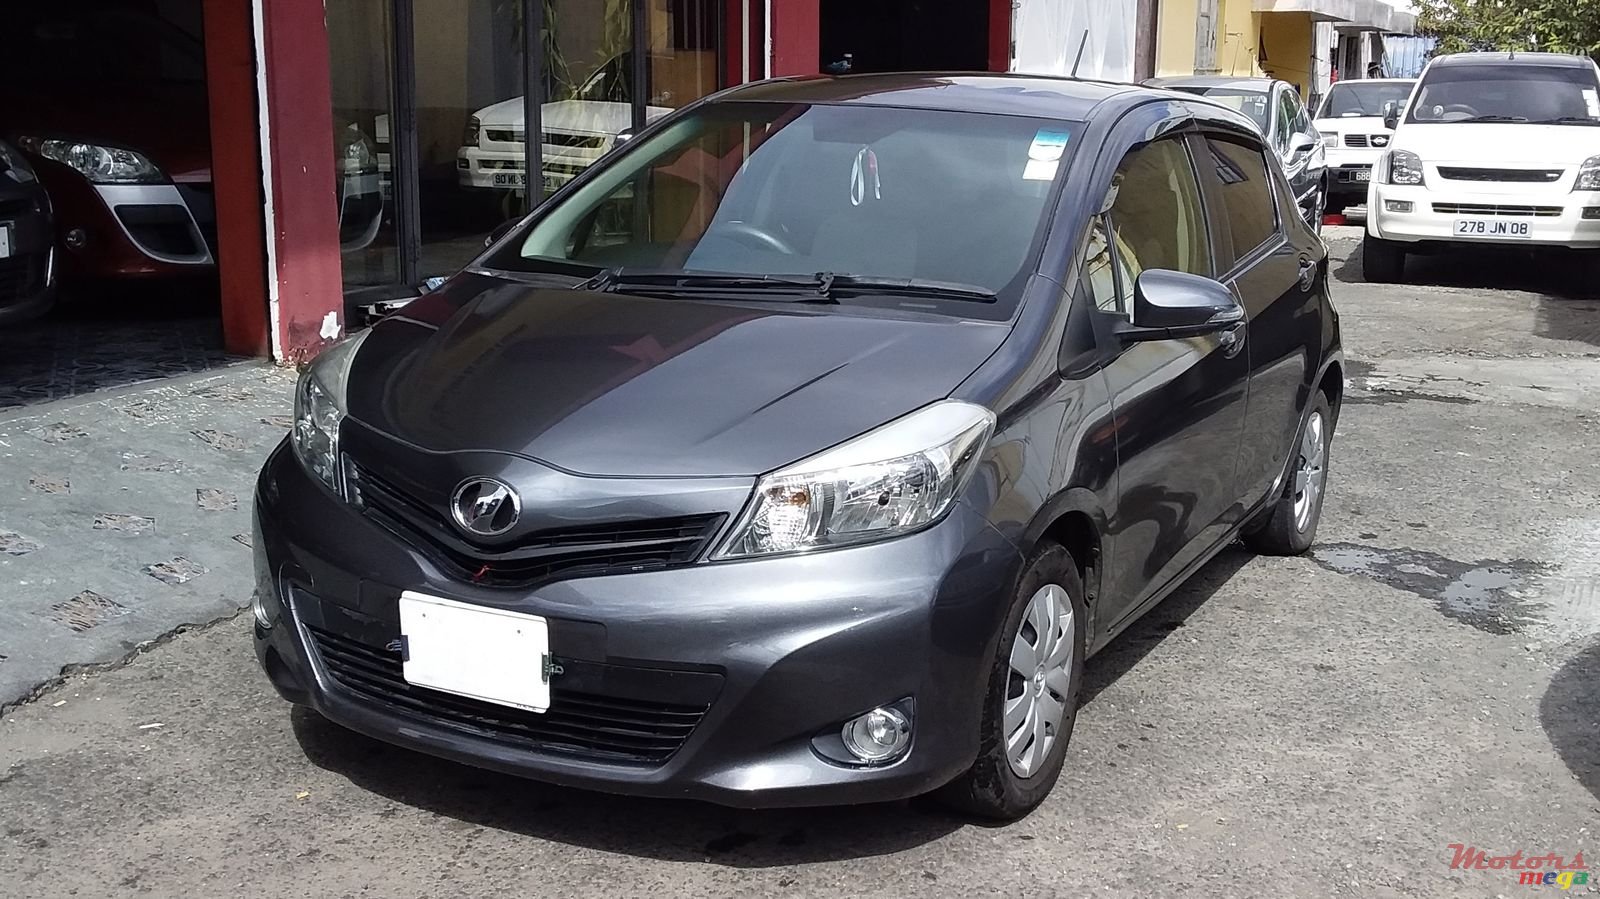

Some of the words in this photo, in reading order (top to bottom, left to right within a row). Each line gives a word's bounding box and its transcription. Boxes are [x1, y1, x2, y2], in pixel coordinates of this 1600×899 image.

[1459, 221, 1485, 233] 278
[1490, 222, 1507, 234] JN
[1511, 223, 1528, 235] 08
